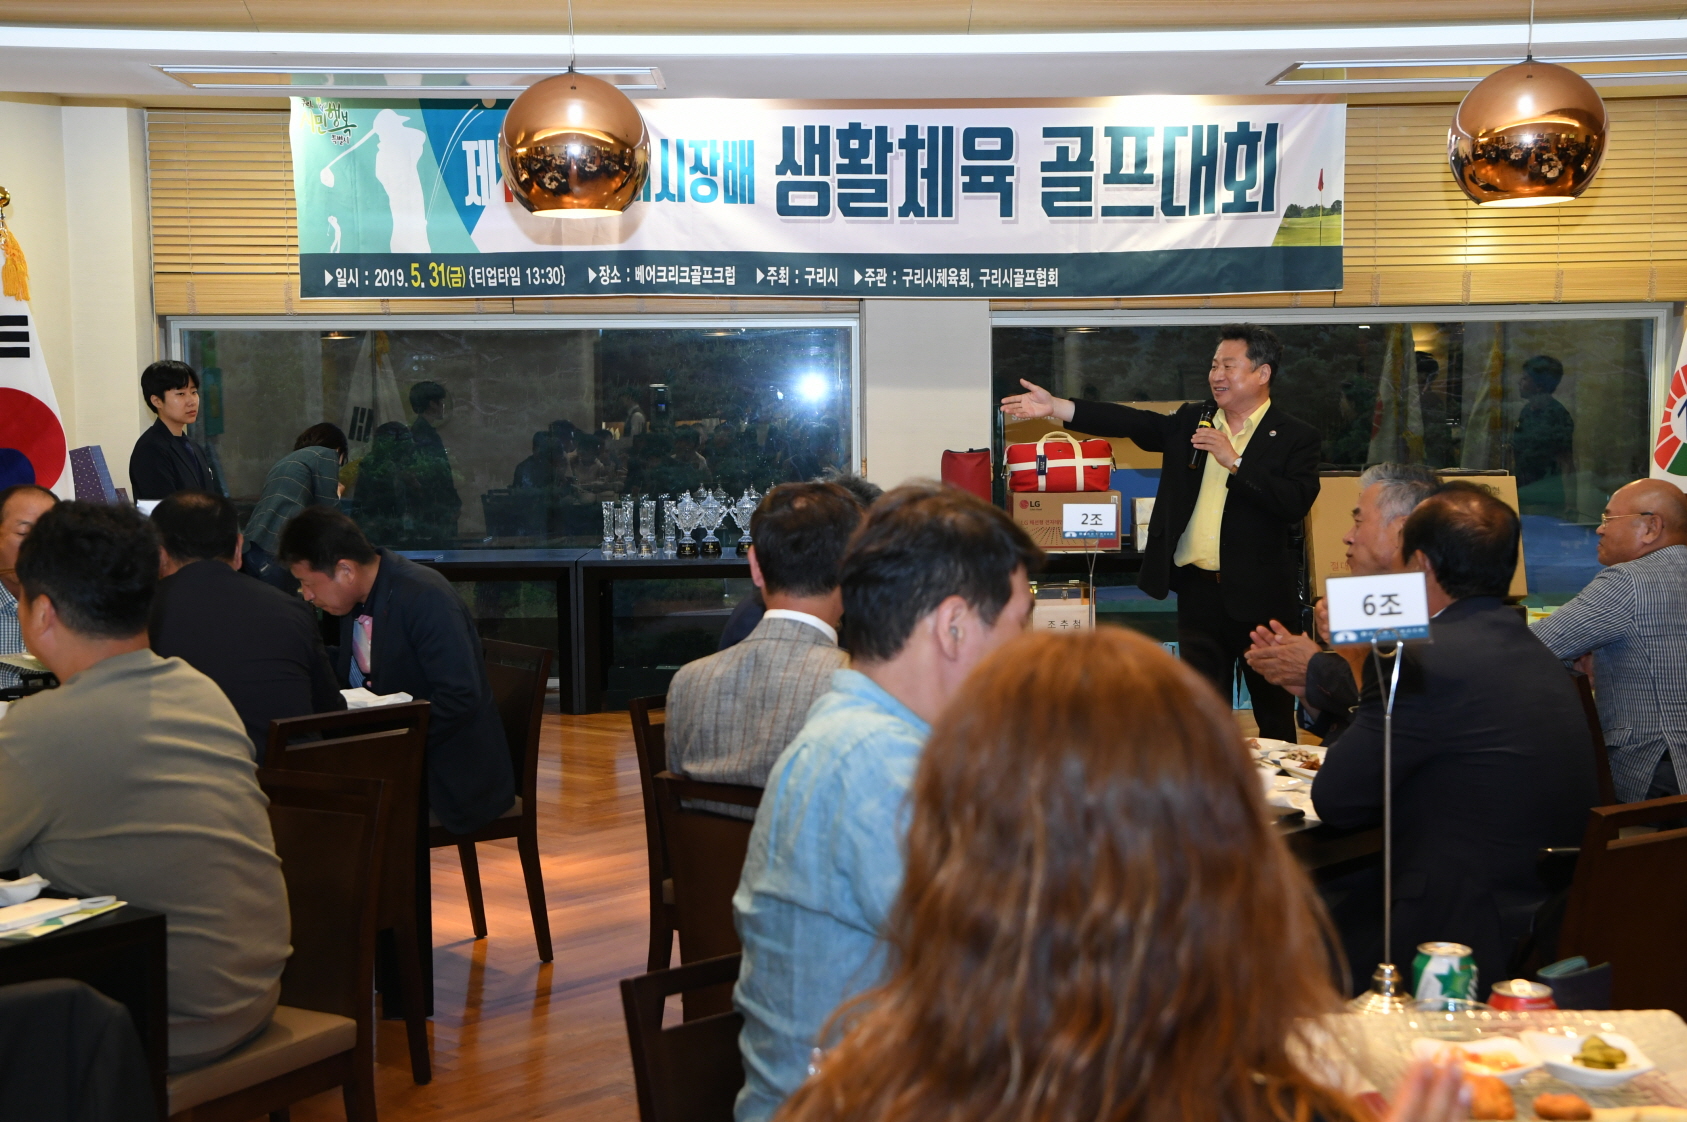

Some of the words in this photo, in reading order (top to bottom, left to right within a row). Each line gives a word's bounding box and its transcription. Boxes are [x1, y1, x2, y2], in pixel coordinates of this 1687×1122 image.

[638, 138, 755, 204] 시장배
[775, 120, 1014, 219] 생활체육
[1040, 121, 1280, 219] 골프대회
[335, 268, 359, 287] 일시
[374, 268, 408, 287] 2019.
[428, 261, 466, 289] 31(금)
[598, 265, 622, 286] 장소
[634, 264, 736, 286] 베어크리크골프크럽
[766, 266, 789, 286] 주최
[804, 266, 839, 287] 구리시
[864, 267, 887, 287] 주관
[902, 267, 974, 289] 구리시체육회,
[979, 267, 1059, 288] 구리시골프협회
[1081, 513, 1103, 526] 2조
[1363, 594, 1402, 616] 6조
